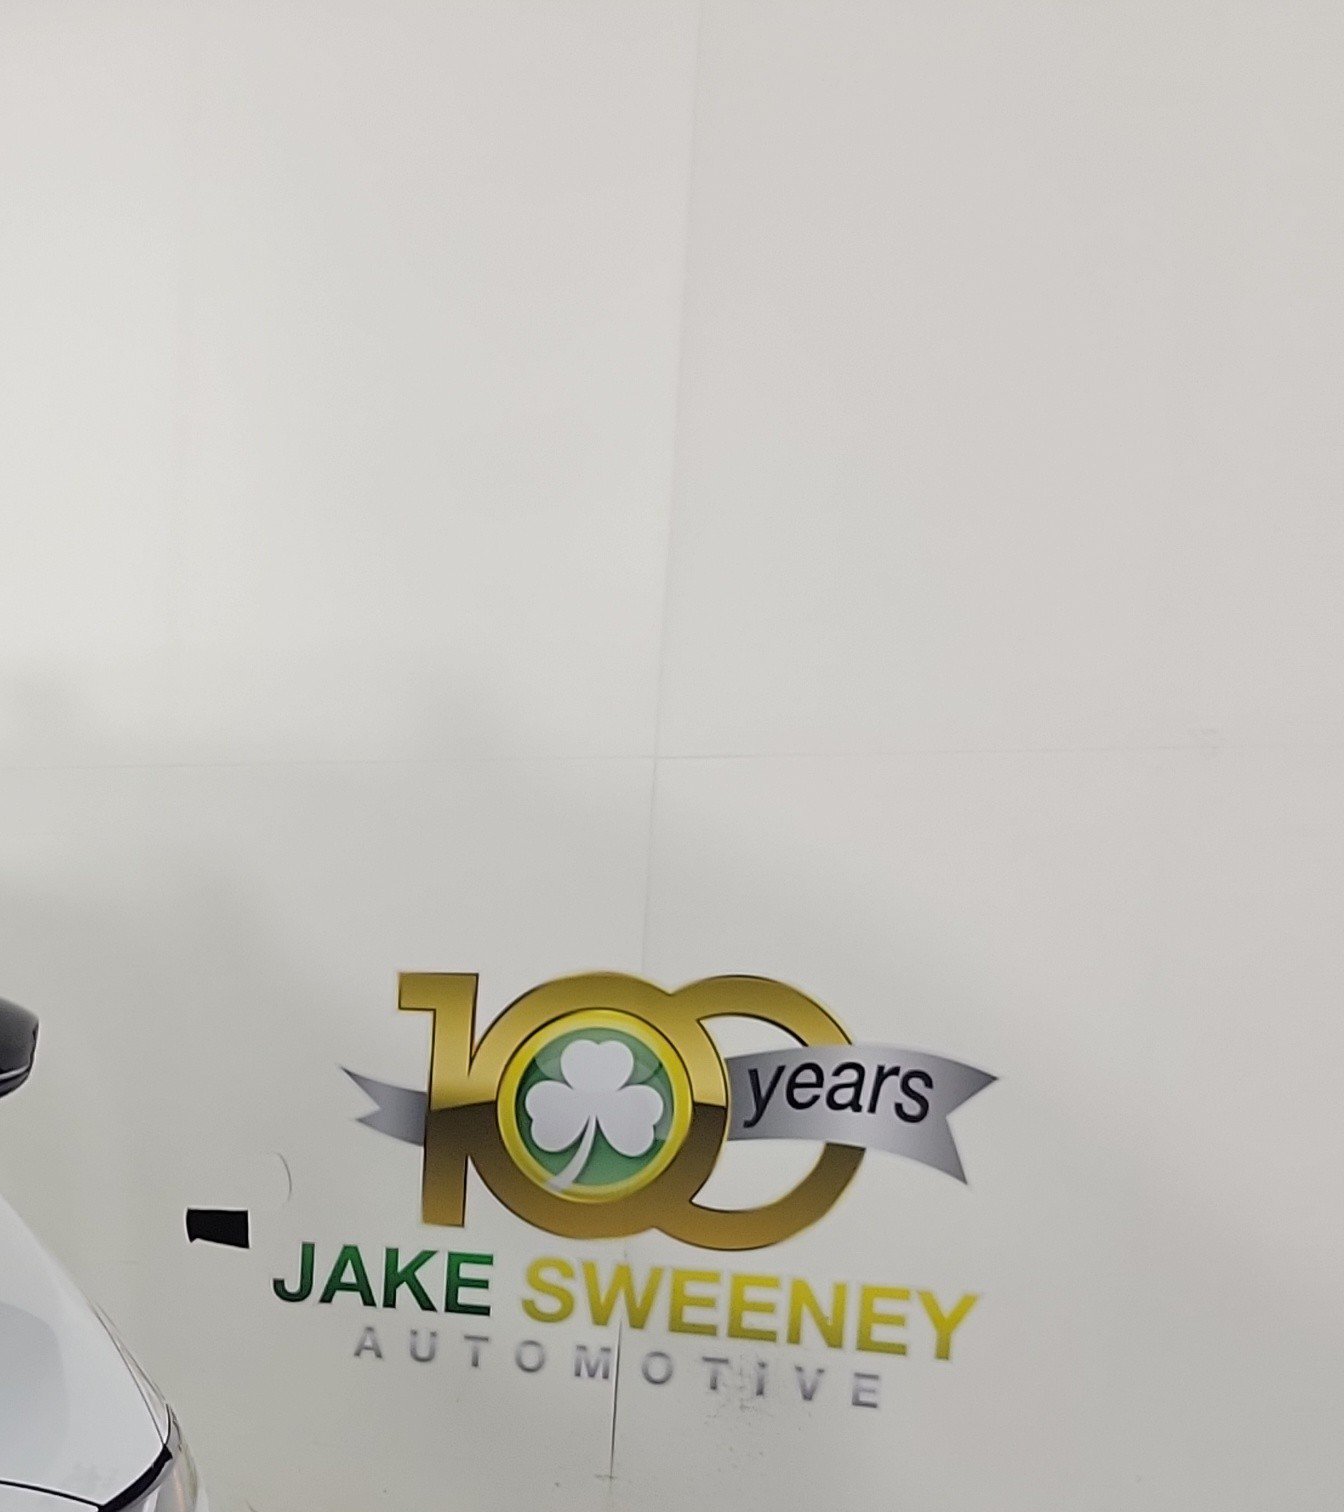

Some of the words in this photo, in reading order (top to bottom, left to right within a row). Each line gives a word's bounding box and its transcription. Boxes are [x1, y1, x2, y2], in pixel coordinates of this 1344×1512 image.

[398, 971, 866, 1251] 100
[743, 1061, 934, 1128] years
[272, 1241, 494, 1316] JAKE
[521, 1257, 979, 1359] SWEENEY
[353, 1325, 880, 1410] AUTOMOTIVE
